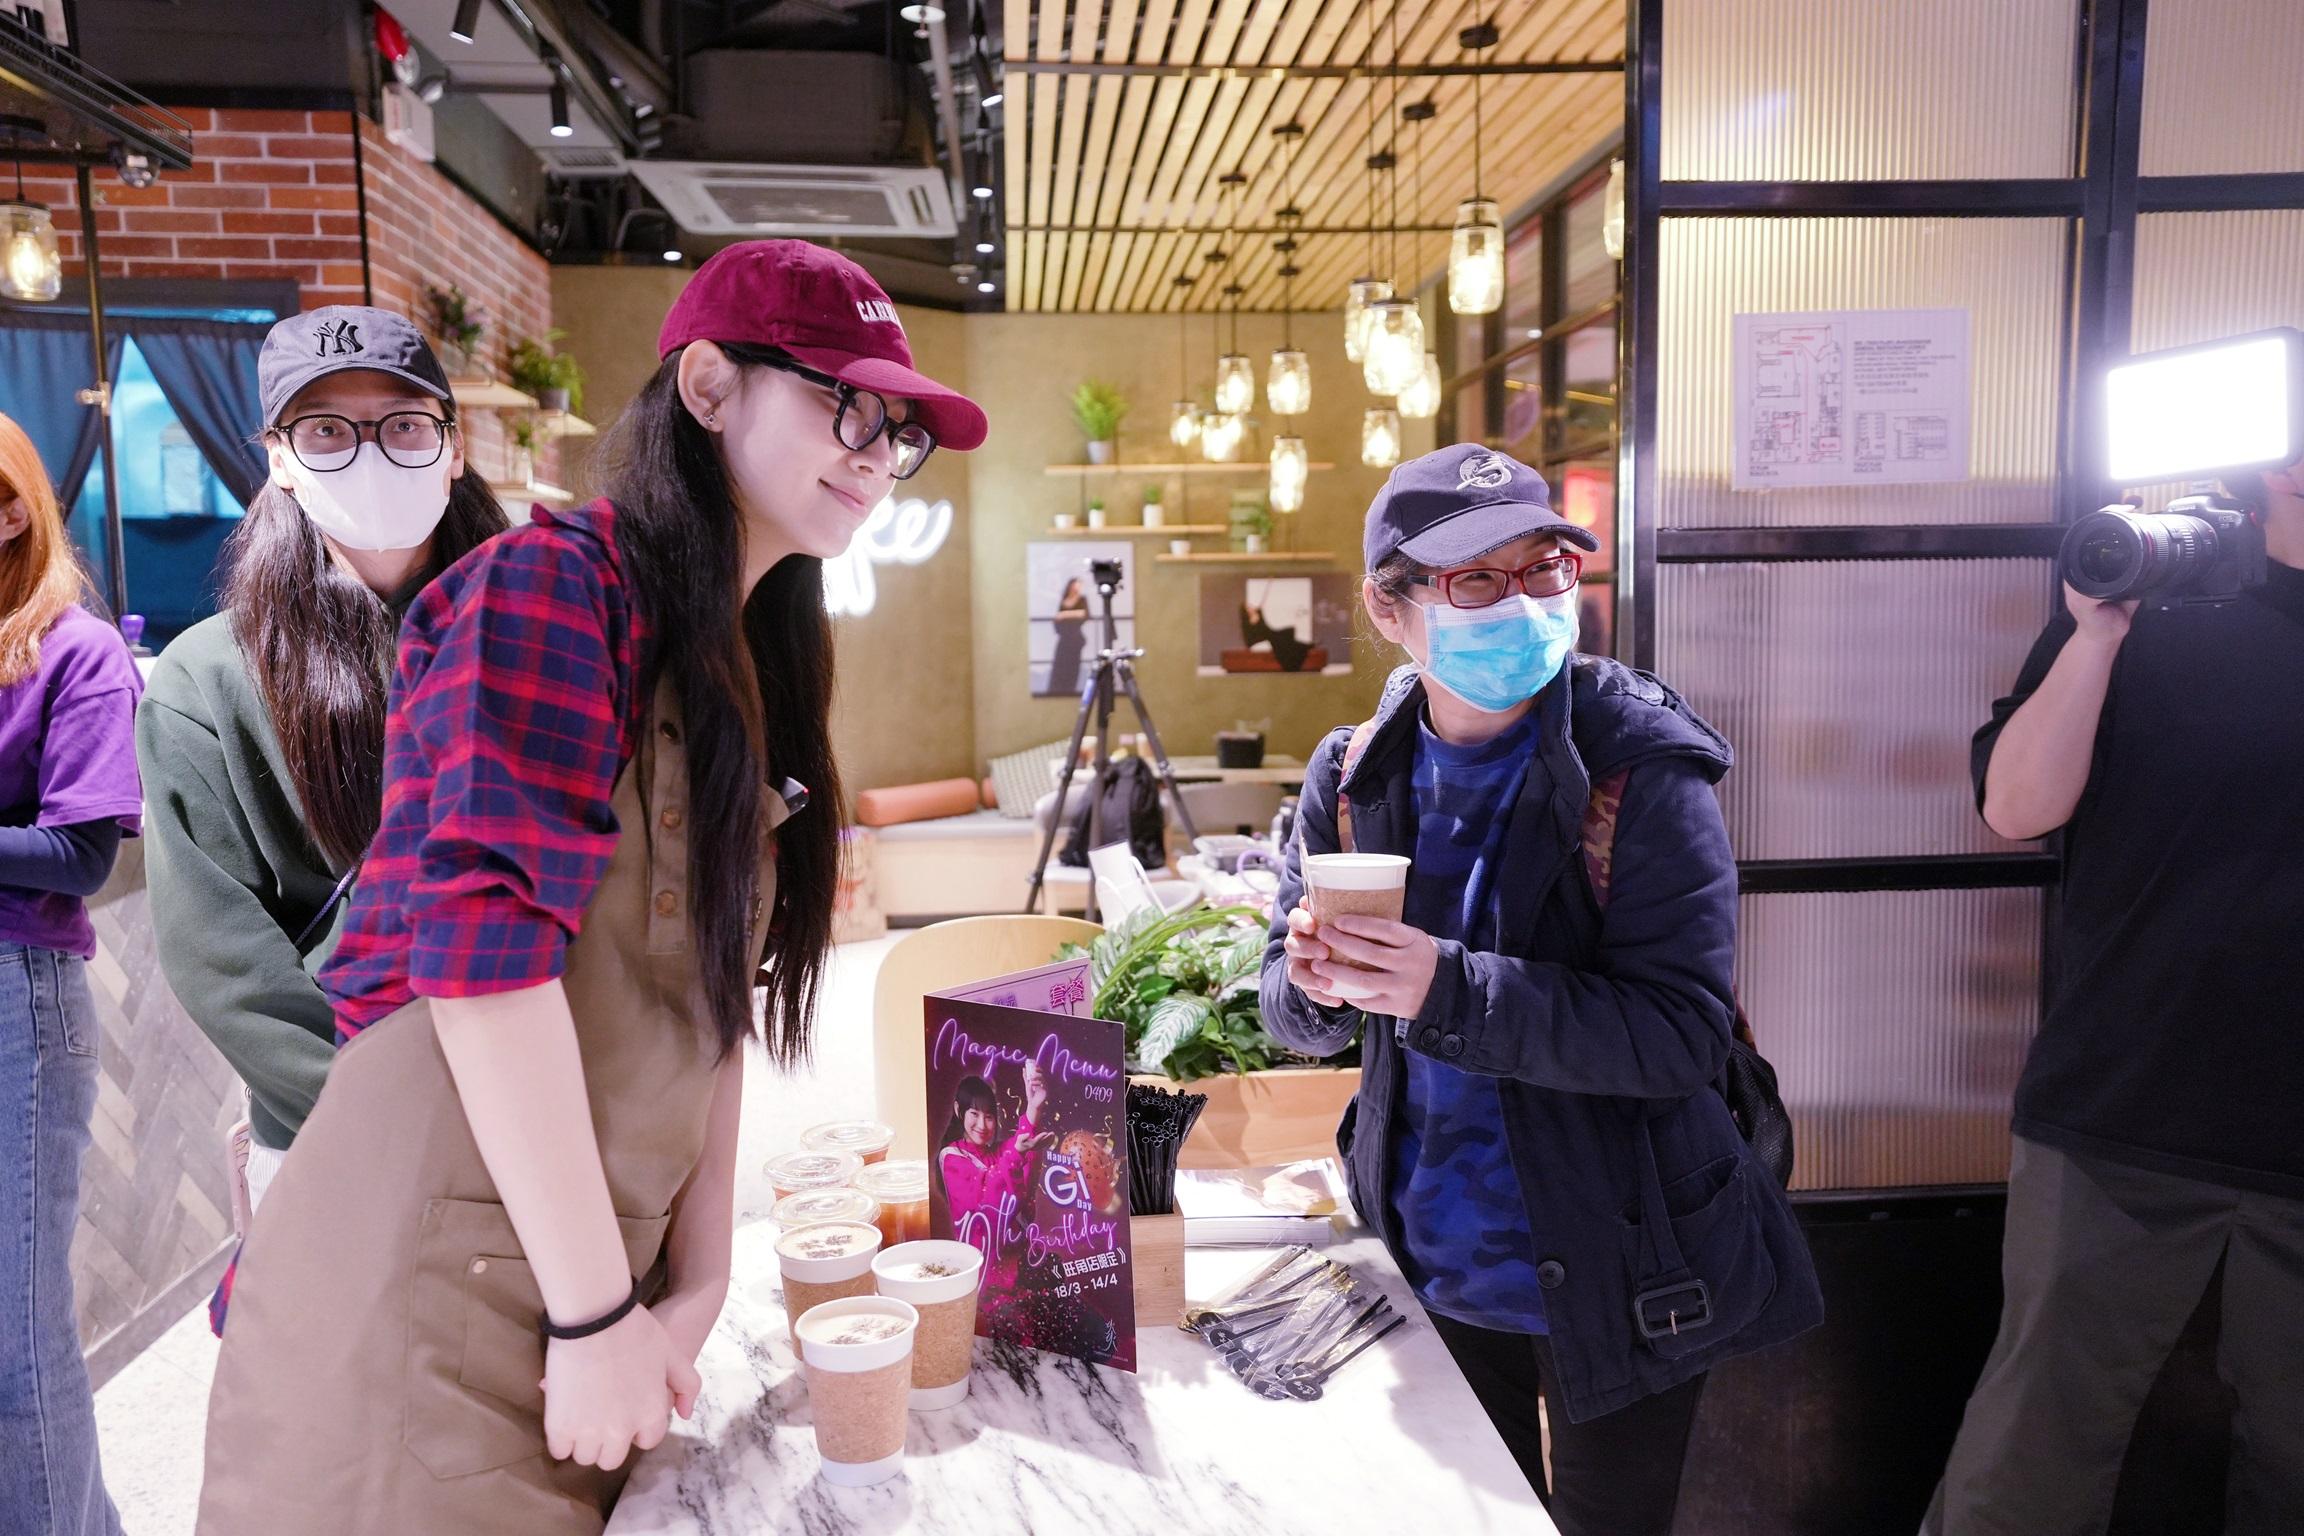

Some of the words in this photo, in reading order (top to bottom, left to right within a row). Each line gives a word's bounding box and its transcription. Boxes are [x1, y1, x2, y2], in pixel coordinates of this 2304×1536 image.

[313, 319, 364, 357] NY
[1050, 978, 1085, 1009] 套餐
[934, 1018, 1028, 1078] Magic
[1036, 1033, 1118, 1083] Menu
[1084, 1084, 1113, 1103] 0409
[1046, 1151, 1073, 1165] Happy
[1077, 1199, 1093, 1211] Day
[1026, 1211, 1118, 1267] Birthday
[1054, 1282, 1082, 1299] 18/3
[1091, 1273, 1118, 1290] 14/4
